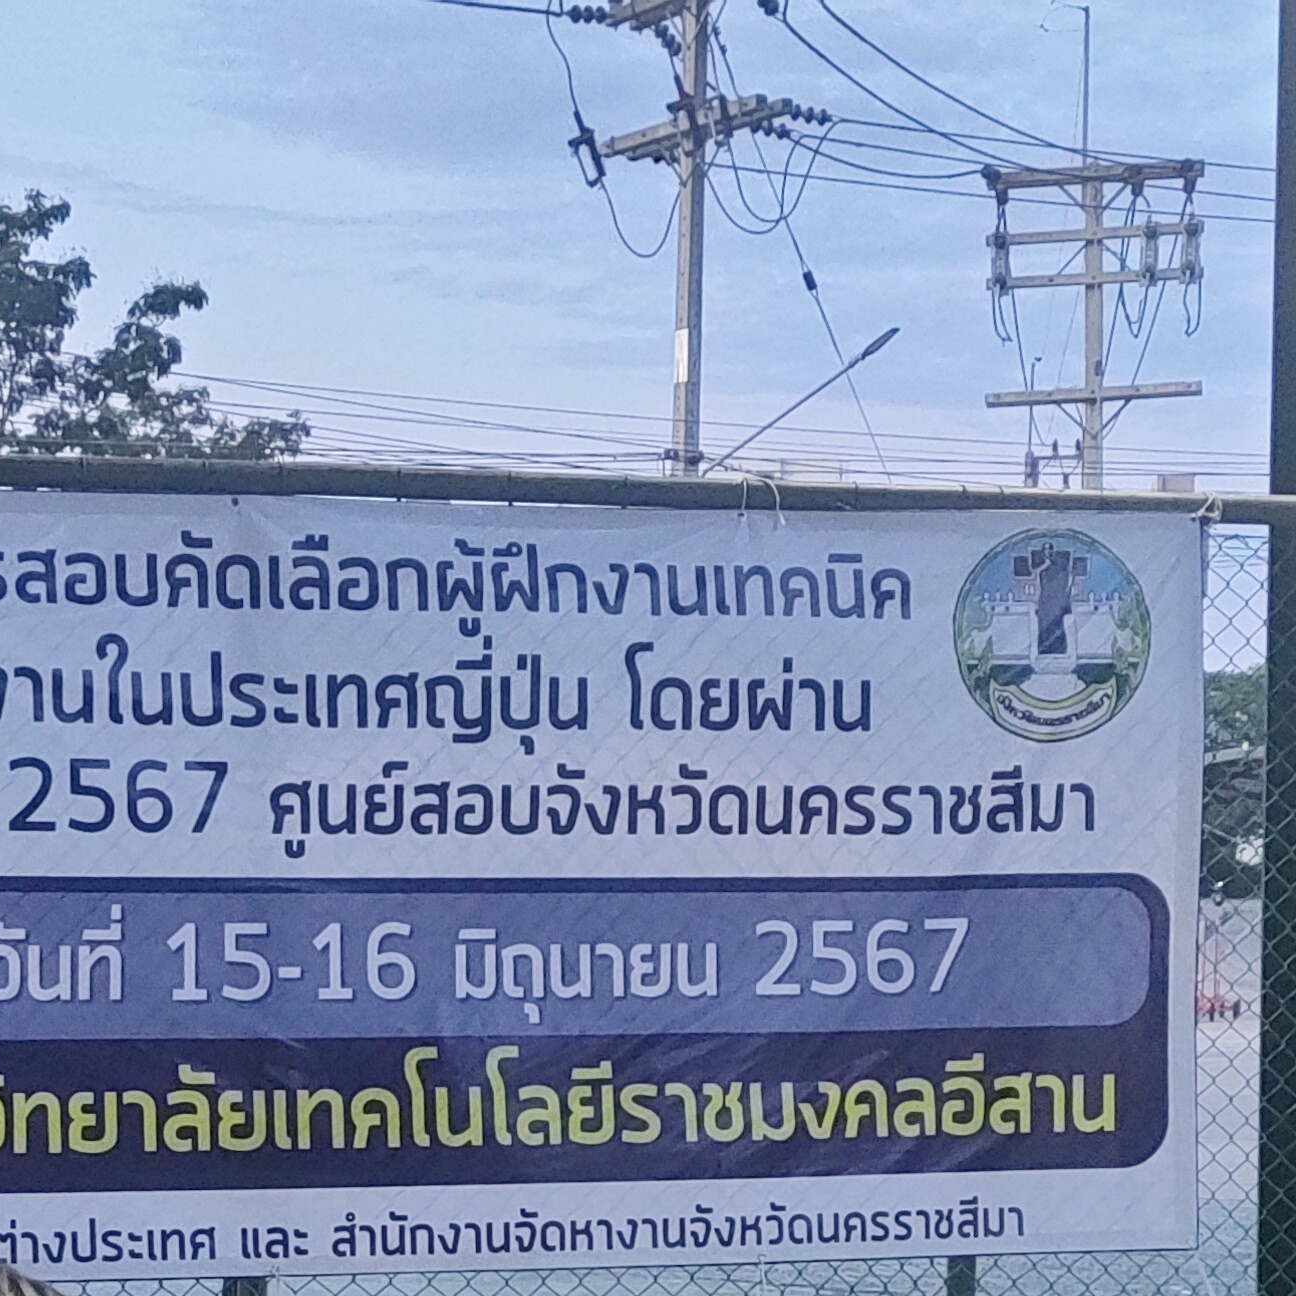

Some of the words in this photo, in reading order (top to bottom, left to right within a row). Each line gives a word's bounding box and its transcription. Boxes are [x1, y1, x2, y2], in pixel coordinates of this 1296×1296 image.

[624, 642, 871, 732] โดยผ่าน
[8, 756, 229, 834] 2567
[269, 759, 1096, 858] ศูนย์สอบจังหวัดนครราชสีมา
[166, 921, 416, 1002] 15-16
[454, 928, 719, 1025] มิถุนายน
[755, 917, 970, 996] 2567
[240, 1226, 309, 1260] และ
[331, 1206, 1026, 1258] สำนักงานจัดหางานจังหวัดนครราชสีมา
